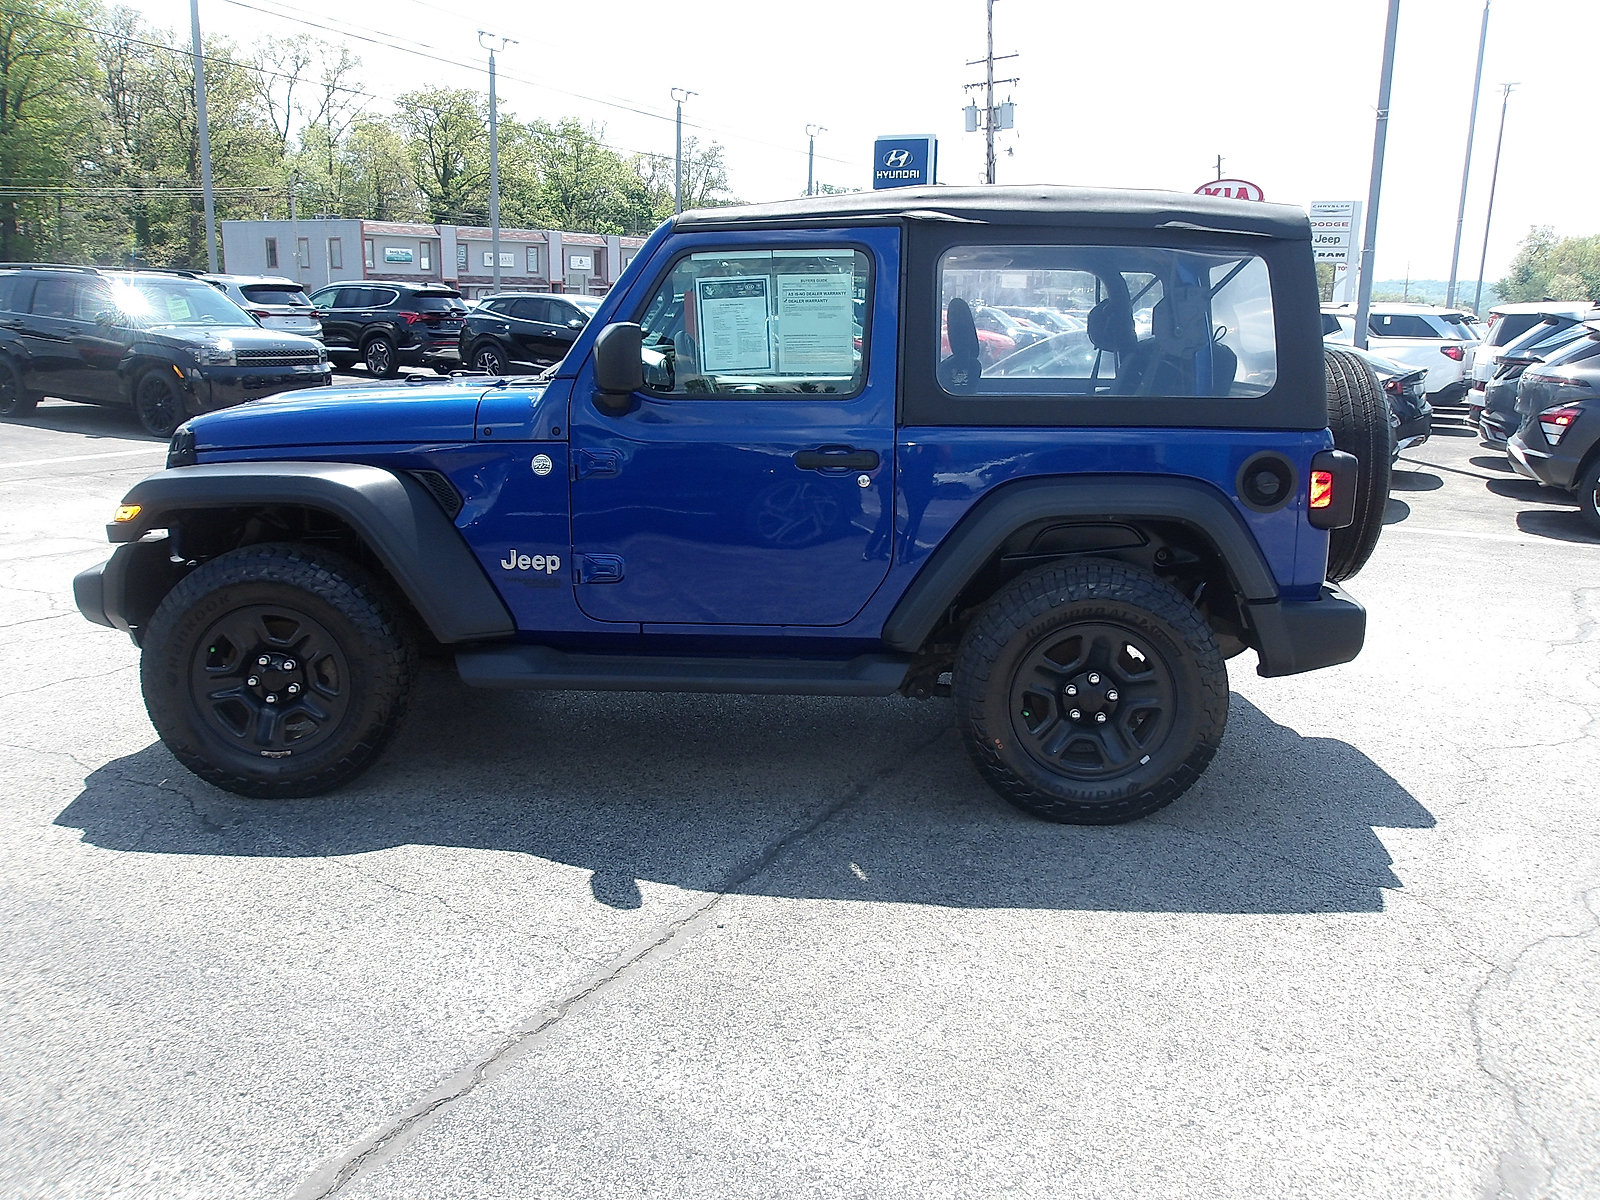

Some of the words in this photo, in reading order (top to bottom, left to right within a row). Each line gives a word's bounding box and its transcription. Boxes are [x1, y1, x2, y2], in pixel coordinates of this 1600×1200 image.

[876, 169, 920, 179] HYUNDAI
[1314, 234, 1341, 245] Jeep
[501, 549, 560, 575] Jeep
